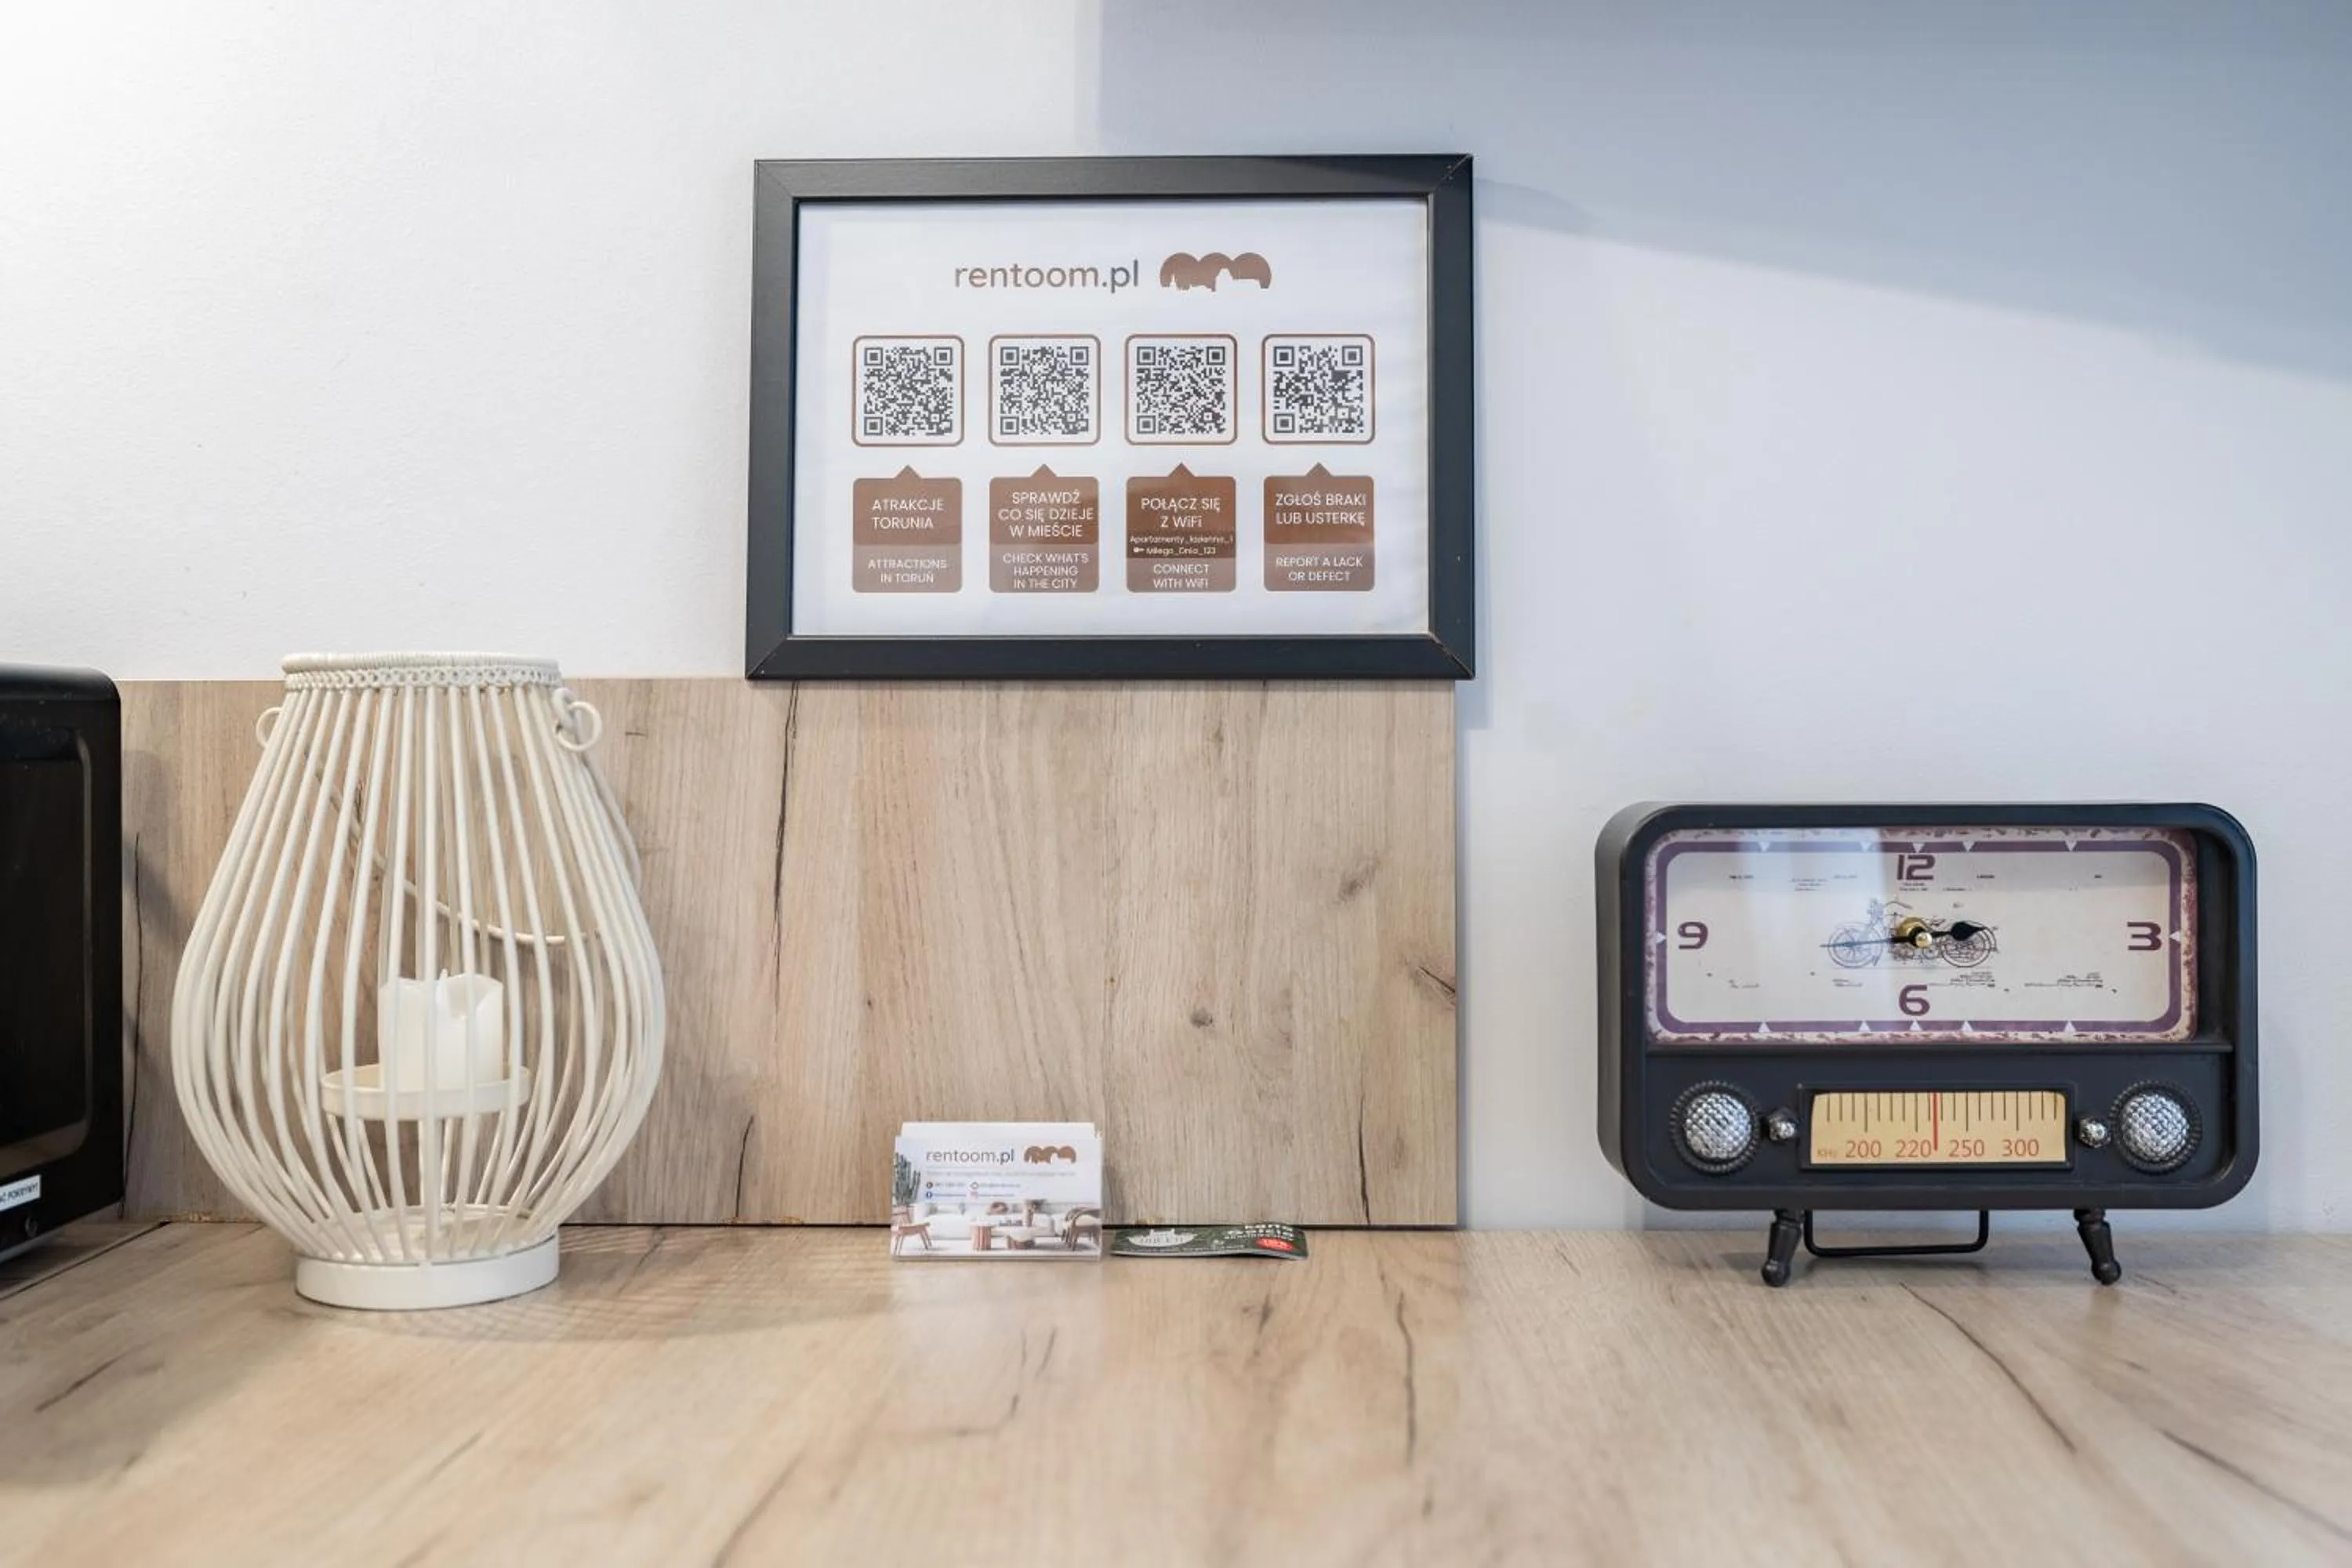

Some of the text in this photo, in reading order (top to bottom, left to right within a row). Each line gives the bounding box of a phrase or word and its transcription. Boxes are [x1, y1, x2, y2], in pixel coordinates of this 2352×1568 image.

[955, 259, 1138, 293] rentoom.pl
[1011, 489, 1080, 505] SPRAWDŹ
[1275, 492, 1367, 506] ZGŁOŚ BRAKI
[872, 499, 945, 511] ATRAKCJE
[1141, 497, 1221, 514] POŁĄCZ SIĘ
[998, 508, 1094, 523] CO SIĘ DZIEJE
[1160, 516, 1203, 528] Z WiFi
[1276, 512, 1366, 527] LUB USTERKĘ
[873, 517, 934, 530] TORUNIA
[1009, 522, 1083, 537] W MIEŚCIE
[868, 558, 947, 570] ATTRACTIONS
[1003, 552, 1043, 564] CHECK
[1276, 555, 1363, 568] REPORT A LACK
[1014, 565, 1079, 576] HAPPENING
[1153, 564, 1210, 575] CONNECT
[1288, 570, 1350, 582] OR DEFECT
[880, 572, 891, 584] IN
[1014, 578, 1078, 590] IN THE CITY
[1153, 577, 1183, 589] WITH
[1896, 854, 1936, 880] 12
[1677, 921, 1709, 950] 9
[2126, 921, 2162, 951] 3
[1898, 984, 1930, 1017] 6
[1845, 1140, 1882, 1158] 200
[1896, 1139, 1932, 1158] 220
[1948, 1139, 1985, 1158] 250
[2002, 1138, 2039, 1157] 300
[926, 1149, 1014, 1164] rentoom.pl
